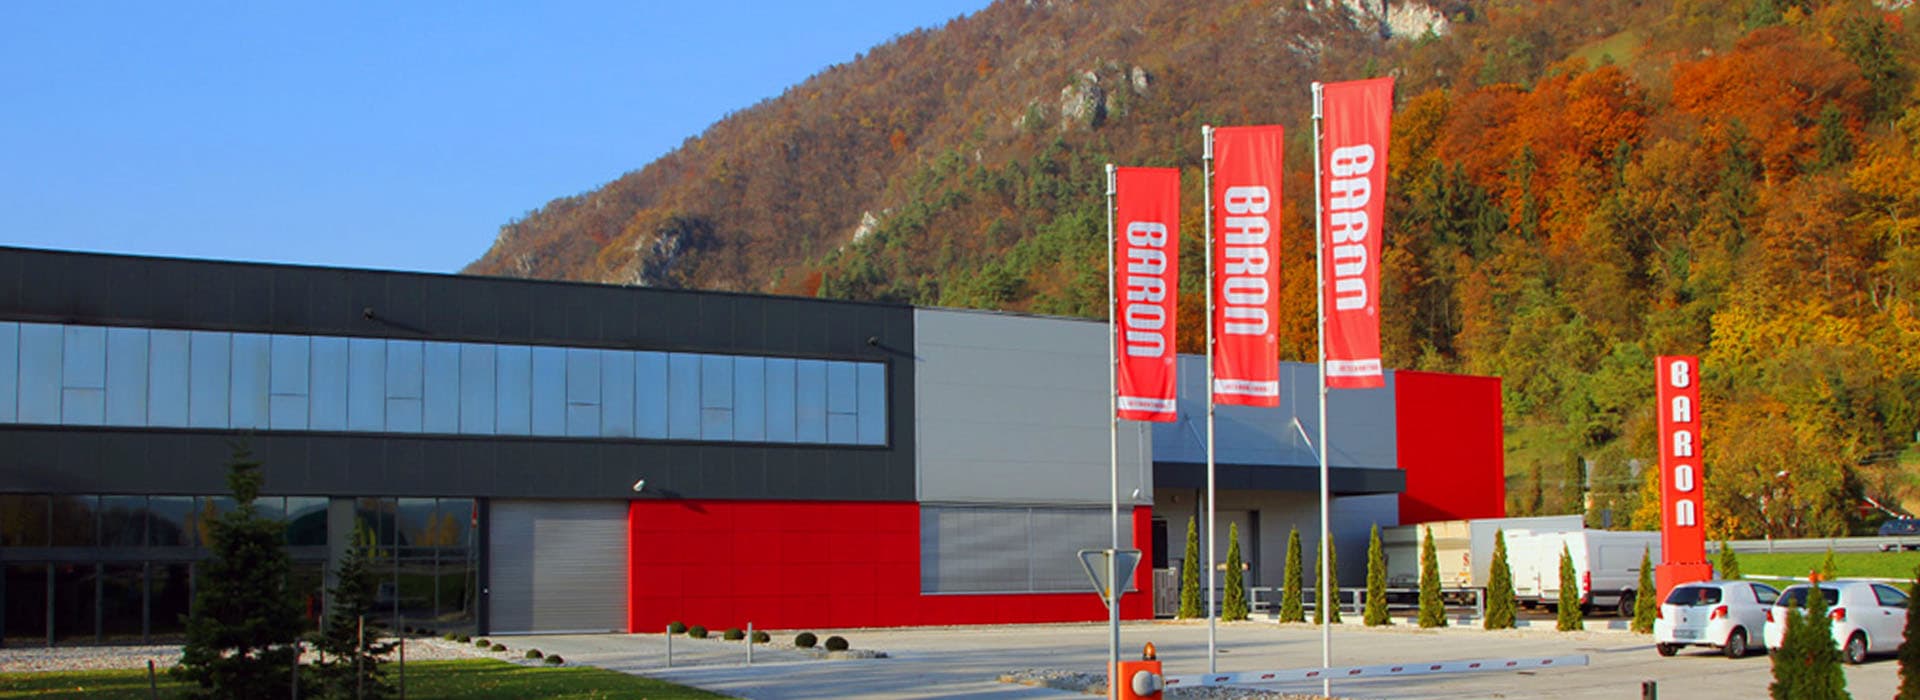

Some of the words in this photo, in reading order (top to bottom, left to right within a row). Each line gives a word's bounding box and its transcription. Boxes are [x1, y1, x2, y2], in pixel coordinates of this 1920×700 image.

[1126, 221, 1168, 358] BARON
[1223, 185, 1270, 336] BARON
[1670, 360, 1696, 527] BARON
